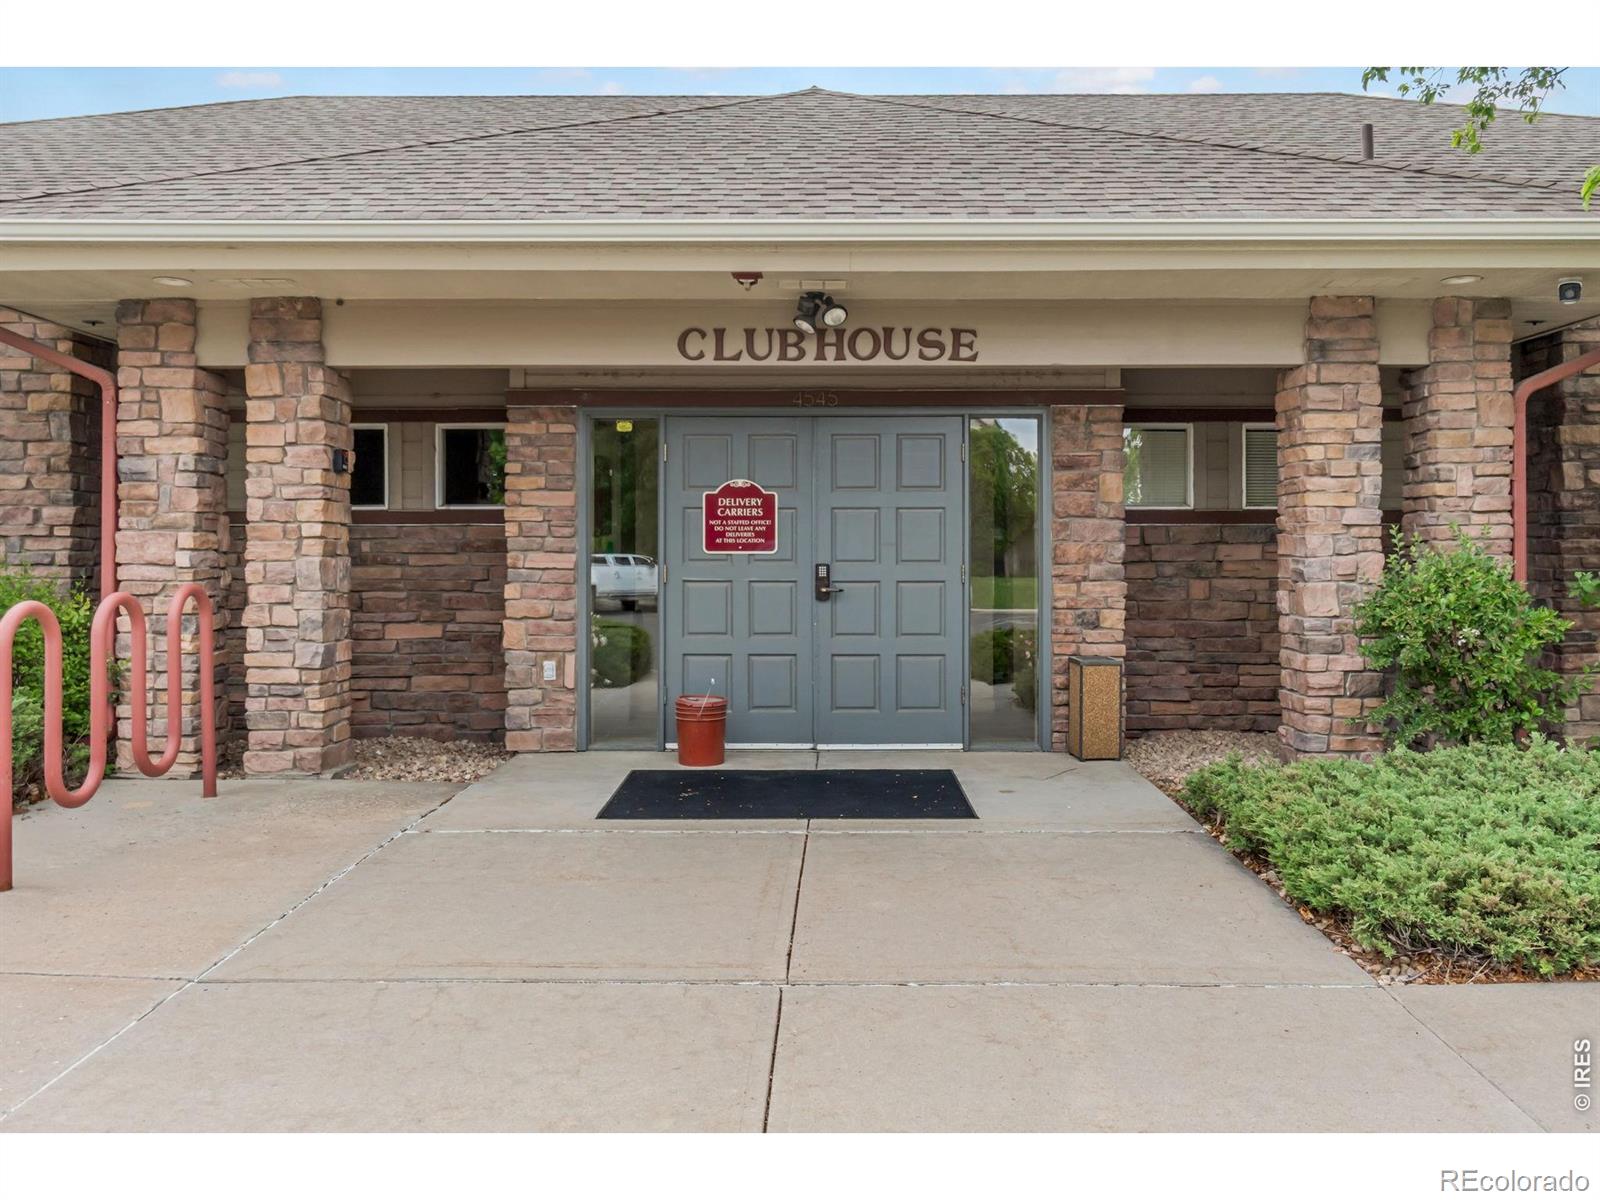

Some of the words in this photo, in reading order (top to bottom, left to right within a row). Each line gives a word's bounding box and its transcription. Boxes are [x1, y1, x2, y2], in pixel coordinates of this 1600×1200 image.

[677, 327, 979, 362] CLUBHOUSE
[792, 391, 839, 407] 4545
[718, 497, 763, 507] DELIVERY
[717, 508, 764, 517] CARRIERS
